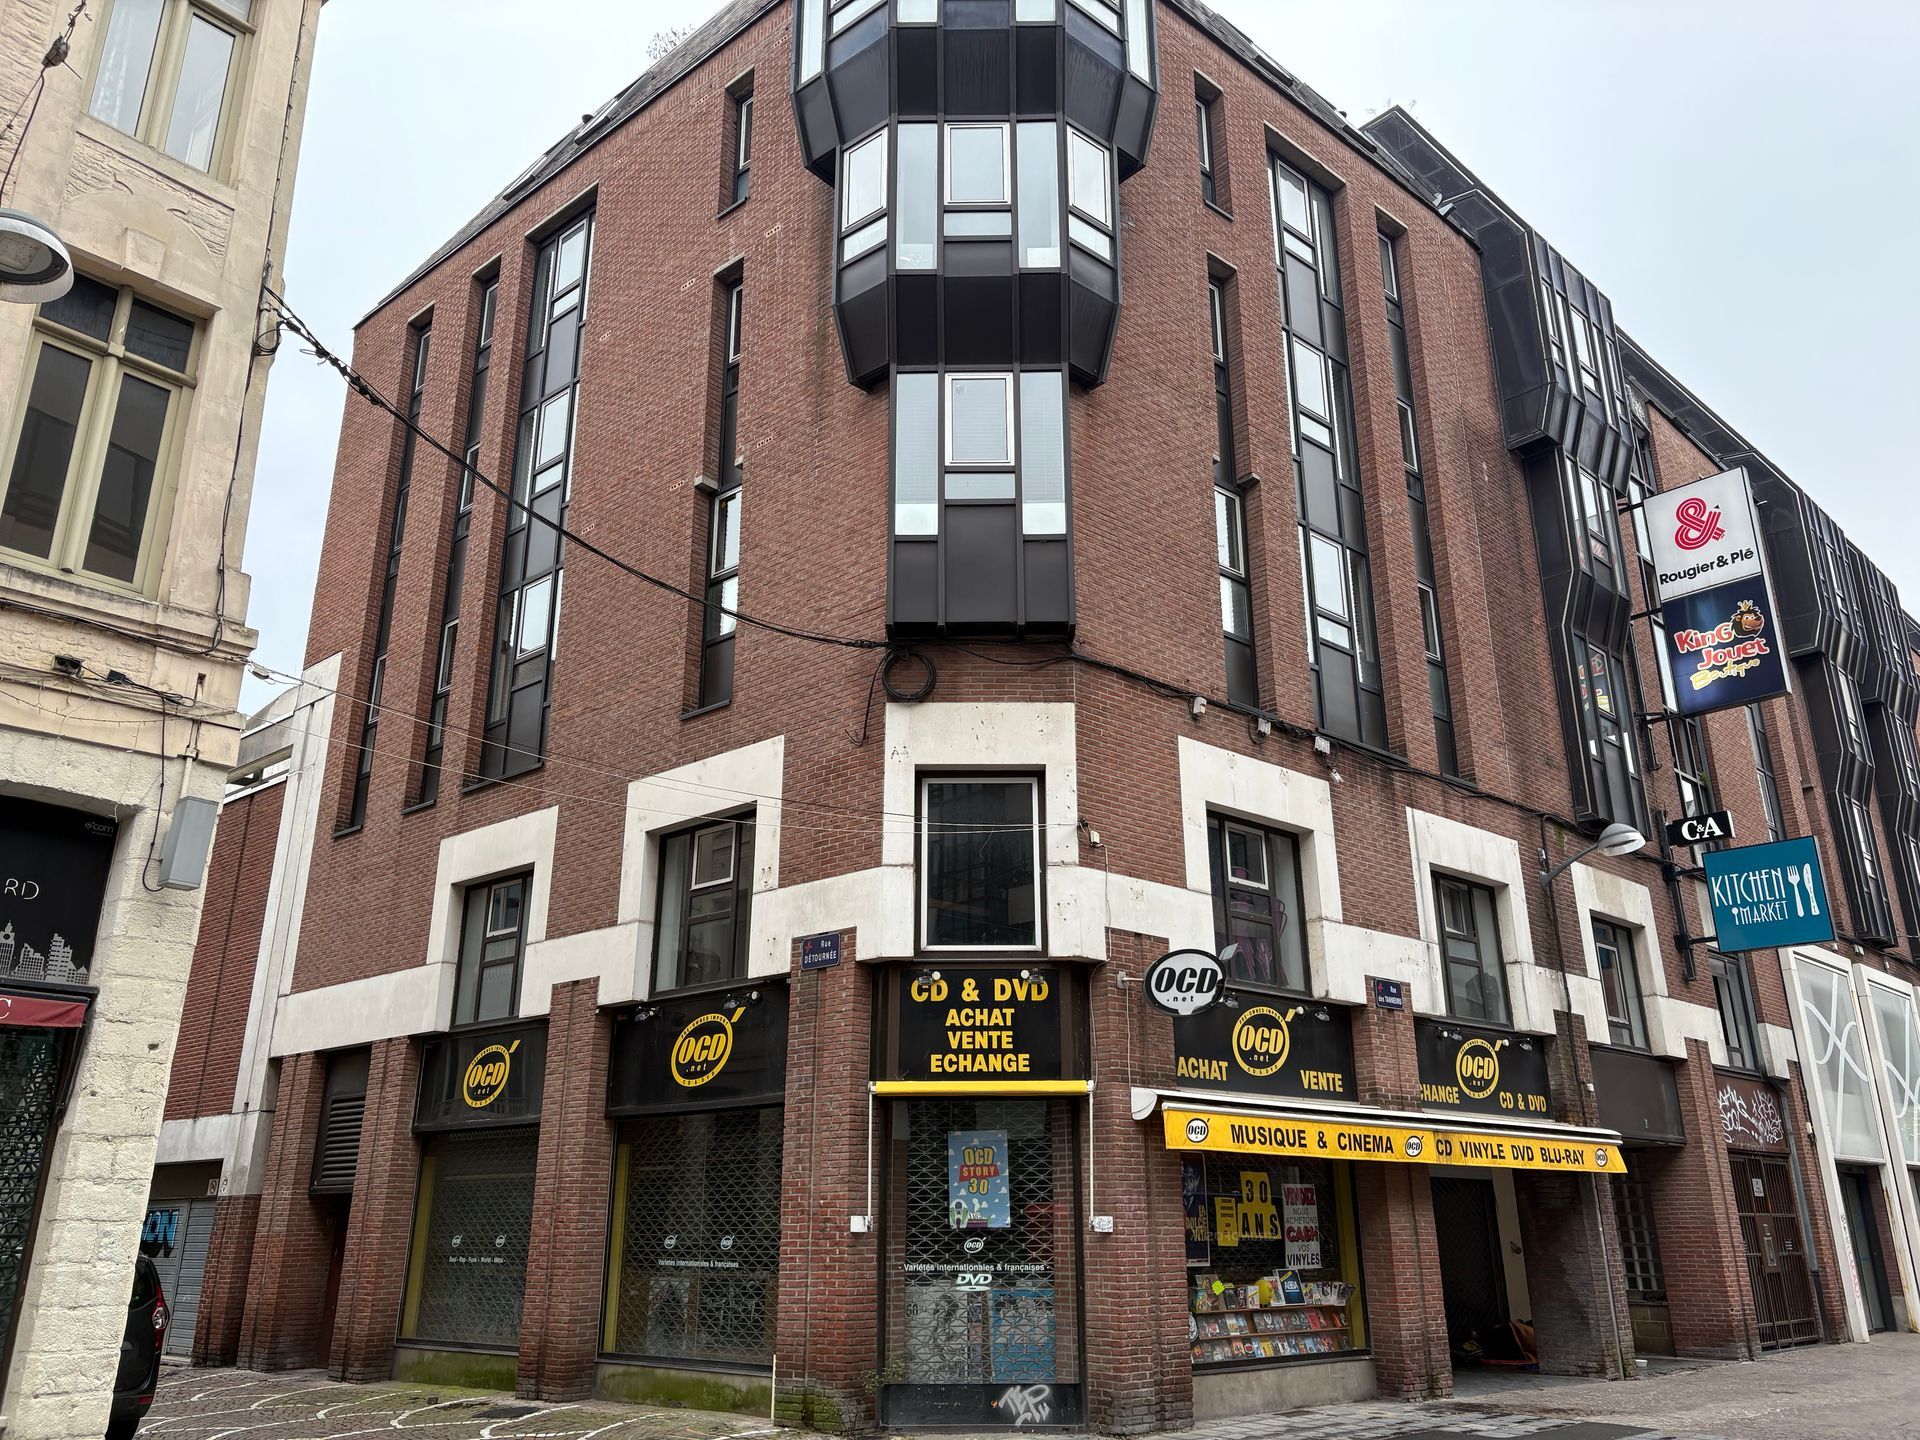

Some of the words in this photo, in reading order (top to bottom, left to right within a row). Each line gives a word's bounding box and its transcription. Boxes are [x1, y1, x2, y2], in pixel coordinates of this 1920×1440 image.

[1659, 559, 1715, 585] Rougier
[1716, 555, 1729, 569] &
[1730, 547, 1755, 565] Plé
[1697, 637, 1771, 671] Jouet
[1689, 657, 1761, 691] Boutique
[1681, 816, 1724, 841] C&A
[1711, 867, 1786, 907] KITCHEN
[820, 940, 831, 948] Rue
[804, 949, 838, 964] DÉTOURNÉE
[910, 978, 949, 1002] CD
[962, 978, 980, 1002] &
[994, 977, 1049, 1002] DVD
[1155, 967, 1219, 993] OCD
[945, 1008, 1015, 1027] ACHAT
[678, 1033, 727, 1064] OCD
[947, 1030, 1014, 1050] VENTE
[1239, 1025, 1284, 1054] OCD
[930, 1053, 1031, 1073] ECHANGE
[1177, 1056, 1228, 1081] ACHAT
[1300, 1070, 1343, 1092] VENTE
[1461, 1054, 1495, 1080] OCD
[468, 1062, 506, 1088] OCD
[1500, 1091, 1514, 1109] CD
[1518, 1093, 1526, 1110] &
[1528, 1094, 1547, 1113] DVD
[1187, 1125, 1206, 1136] OCD
[1230, 1124, 1307, 1149] MUSIQUE
[1317, 1131, 1328, 1149] &
[1337, 1132, 1394, 1154] CINEMA
[1405, 1138, 1421, 1151] OCD
[1435, 1138, 1453, 1158] CD
[1459, 1140, 1506, 1160] VINYLE
[1510, 1144, 1535, 1162] DVD
[1541, 1147, 1585, 1165] BLU-RAY
[963, 1147, 994, 1167] OCD
[962, 1166, 996, 1177] STORY
[968, 1177, 990, 1195] 30
[1245, 1179, 1269, 1203] 30
[1292, 1207, 1310, 1216] NOUS
[1241, 1212, 1279, 1237] ANS
[1286, 1225, 1319, 1242] CASH
[966, 1241, 982, 1250] OCD
[1297, 1244, 1311, 1252] VOS
[937, 1262, 995, 1272] internationales
[996, 1263, 1003, 1272] &
[1004, 1263, 1045, 1274] françaises
[1287, 1253, 1320, 1267] VINYLES
[956, 1273, 993, 1286] DVD
